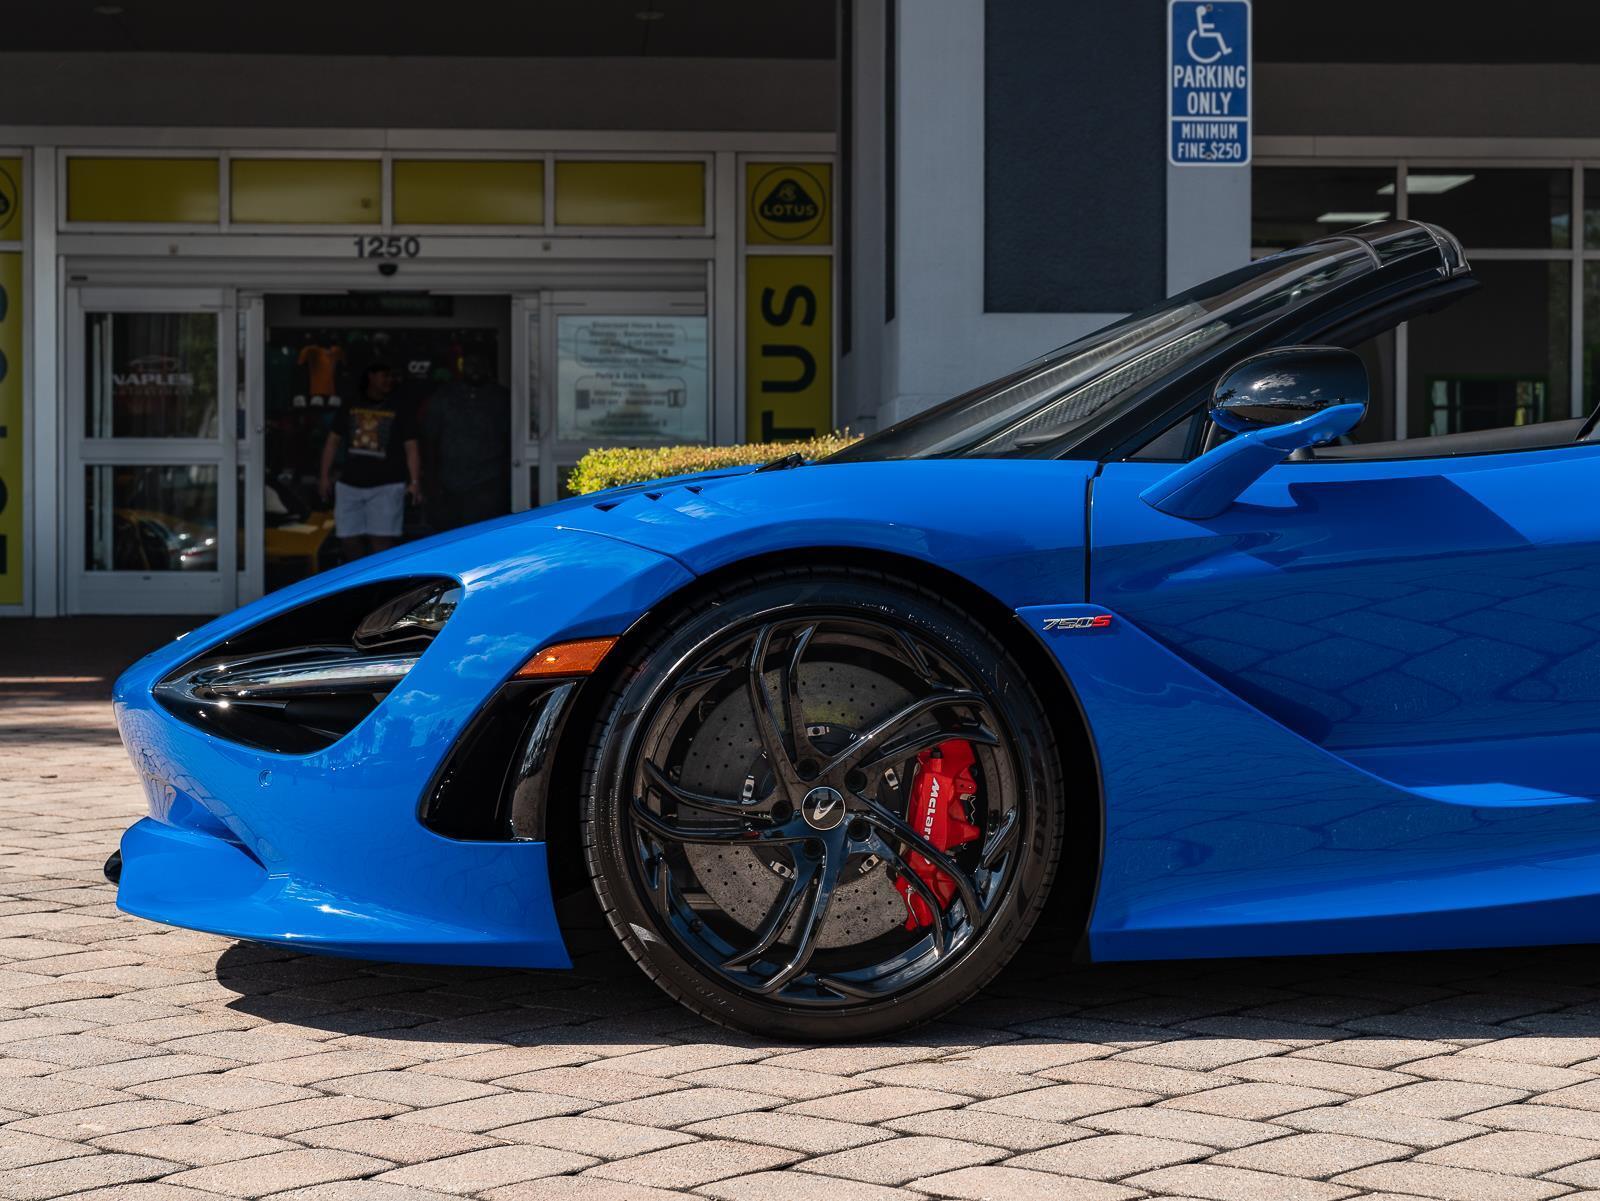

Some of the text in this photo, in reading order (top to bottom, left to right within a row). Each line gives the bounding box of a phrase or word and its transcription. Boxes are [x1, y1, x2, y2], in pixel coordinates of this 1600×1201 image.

[1173, 65, 1247, 89] PARKING
[1187, 92, 1232, 115] ONLY
[1181, 123, 1238, 140] MINIMUM
[1178, 141, 1242, 161] FINE $250
[763, 204, 815, 216] LOTUS
[353, 237, 421, 258] 1250
[113, 373, 195, 386] NAPLES
[1043, 615, 1113, 631] 750S
